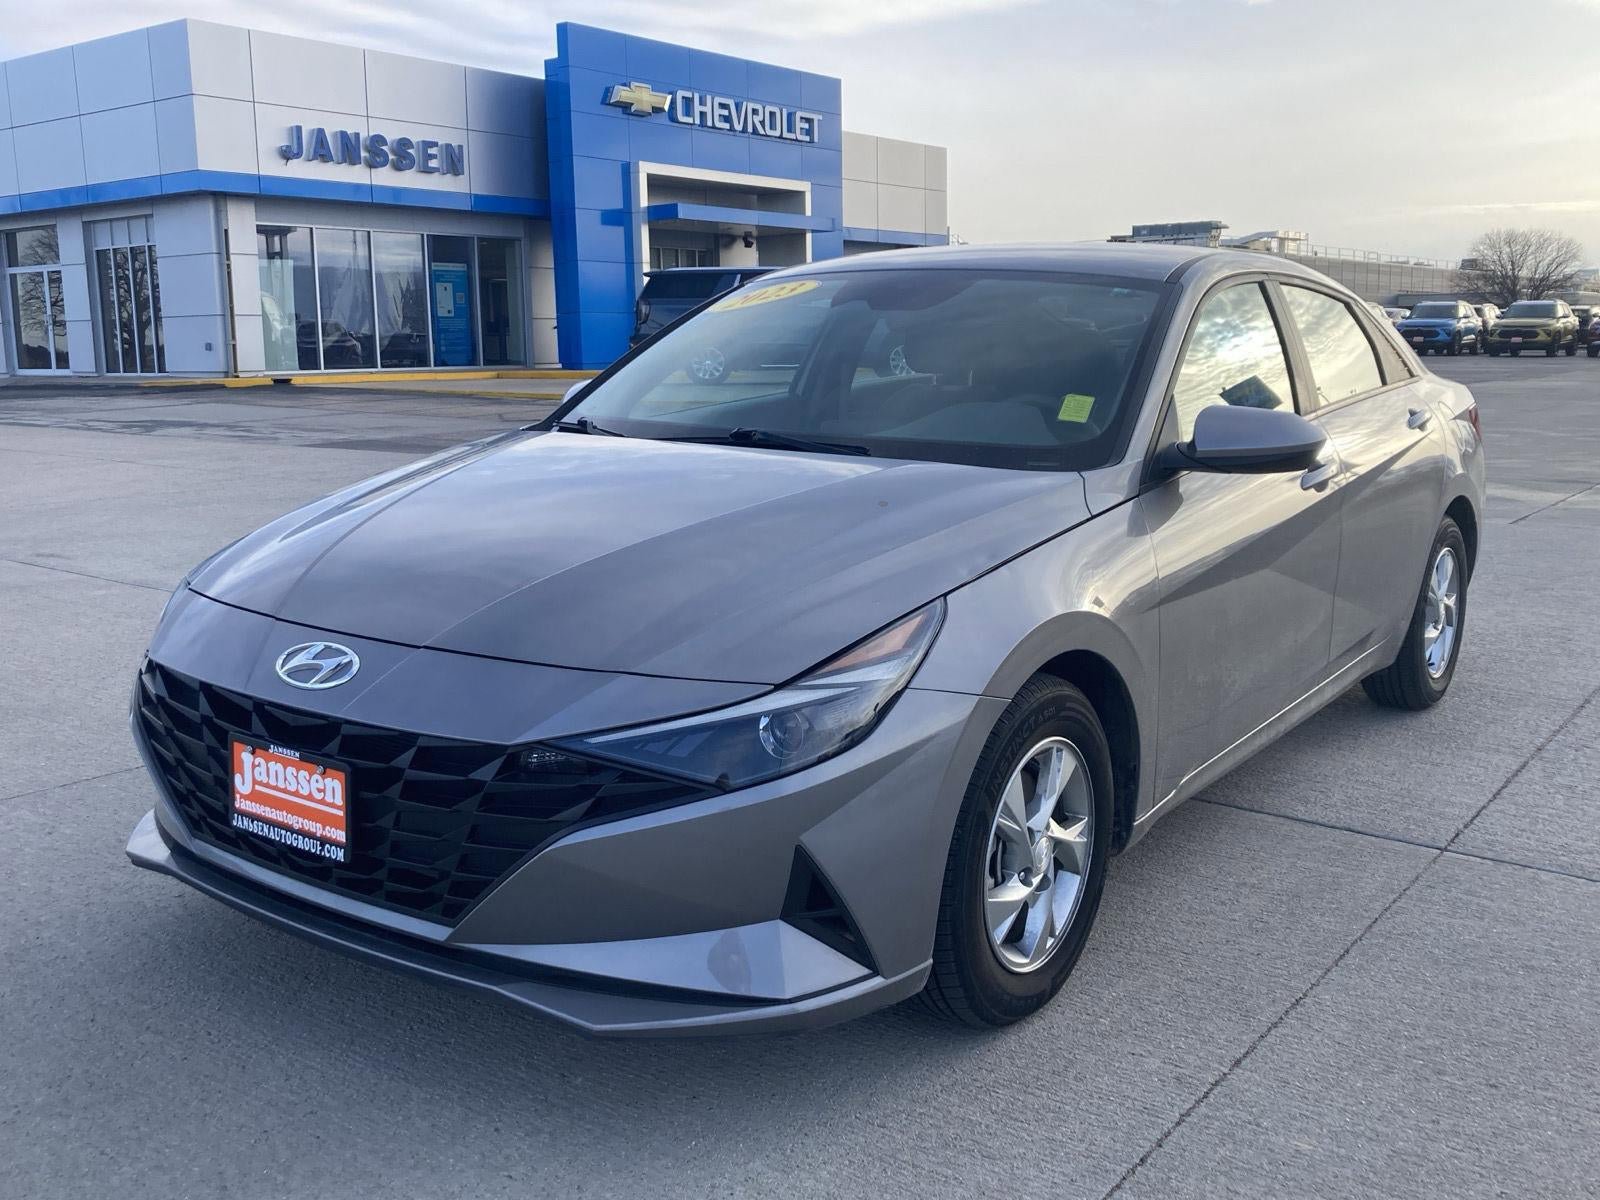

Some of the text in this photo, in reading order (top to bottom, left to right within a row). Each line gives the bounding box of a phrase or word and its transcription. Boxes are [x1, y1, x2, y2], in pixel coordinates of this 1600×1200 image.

[674, 88, 823, 143] CHEVROLET
[279, 124, 465, 177] JANSSEN
[268, 744, 300, 759] JANSSEN
[234, 750, 344, 806] Janssen
[232, 813, 345, 862] JANSSENAUTOGROUP.COM
[234, 793, 346, 843] Janssenautogroup.com
